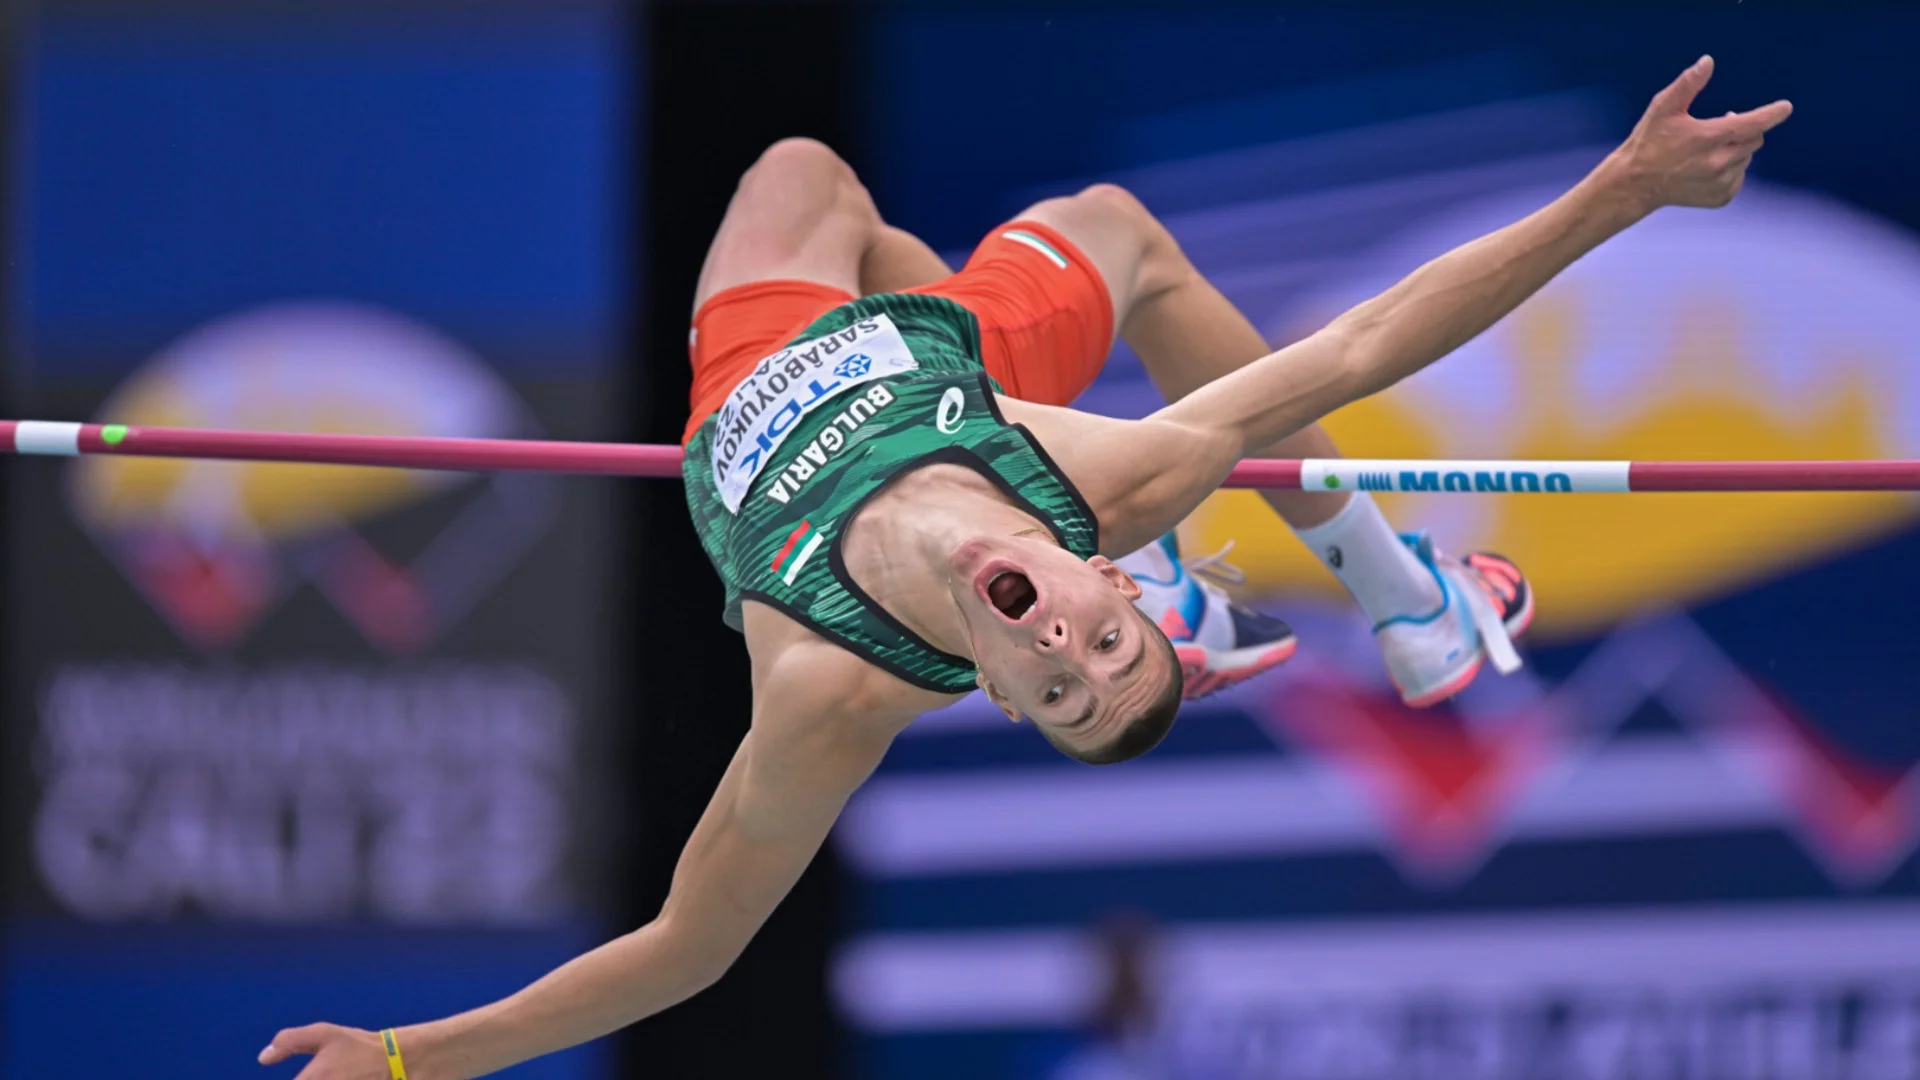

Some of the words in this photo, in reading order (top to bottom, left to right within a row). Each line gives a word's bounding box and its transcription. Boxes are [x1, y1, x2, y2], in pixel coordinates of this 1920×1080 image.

[736, 350, 793, 401] CALI
[739, 379, 841, 479] TDK
[767, 384, 894, 504] BULGARIA
[1399, 471, 1573, 492] MONDO
